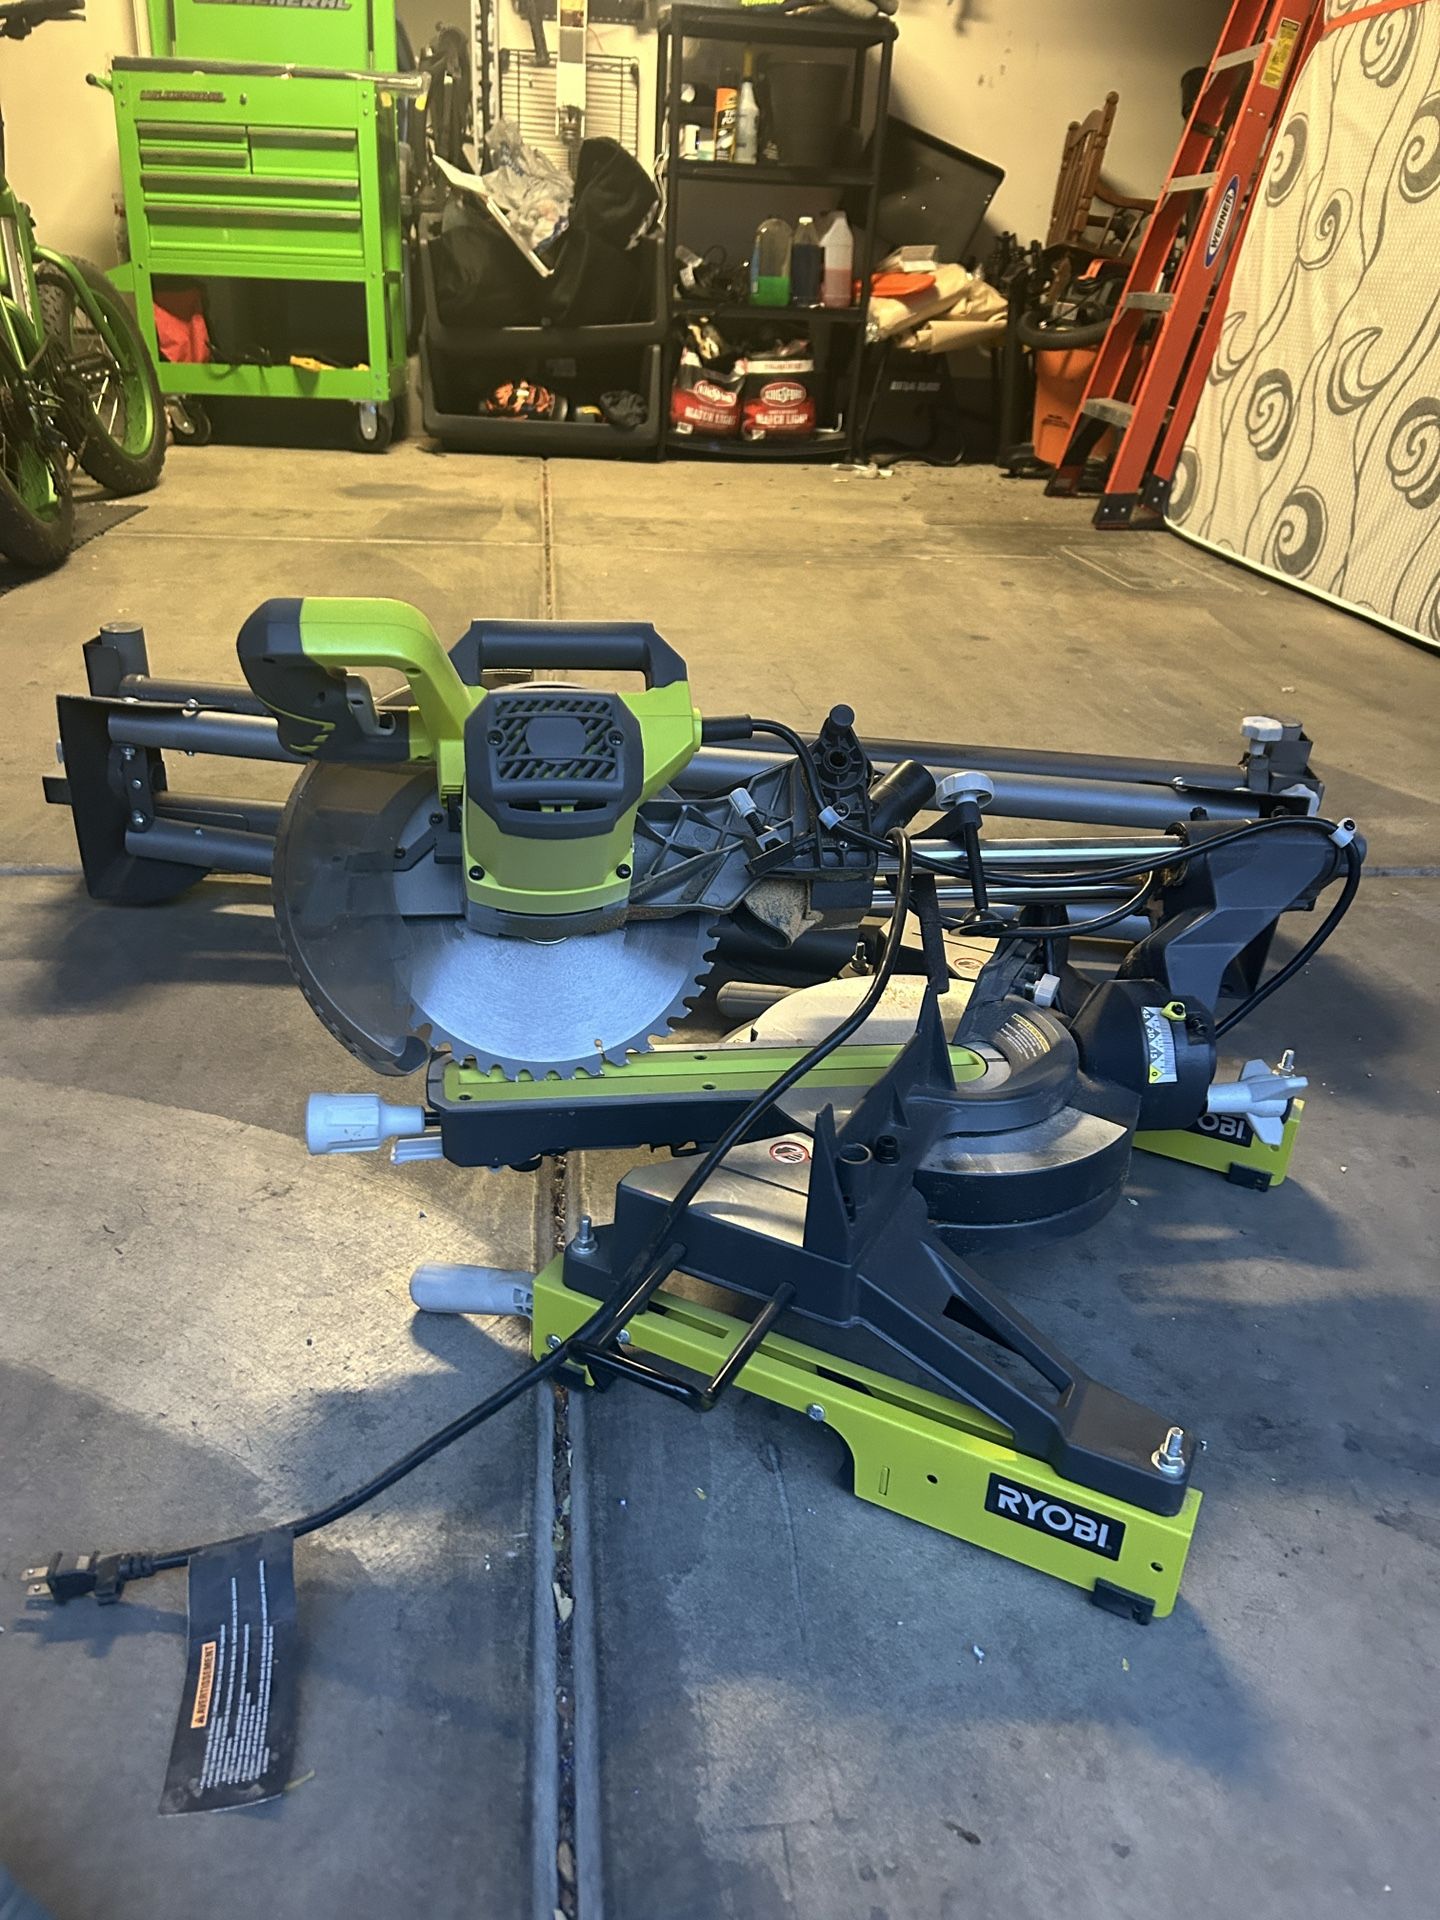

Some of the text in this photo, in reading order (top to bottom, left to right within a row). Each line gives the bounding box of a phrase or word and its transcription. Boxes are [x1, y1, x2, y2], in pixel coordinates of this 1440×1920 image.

[1211, 194, 1233, 247] WERNER
[1142, 1008, 1151, 1019] 45
[1146, 1028, 1155, 1039] 30
[1150, 1049, 1158, 1059] 15
[1198, 1113, 1245, 1139] OBI
[998, 1484, 1109, 1548] RYOBI
[197, 1645, 214, 1714] AVERTISSEMENT
